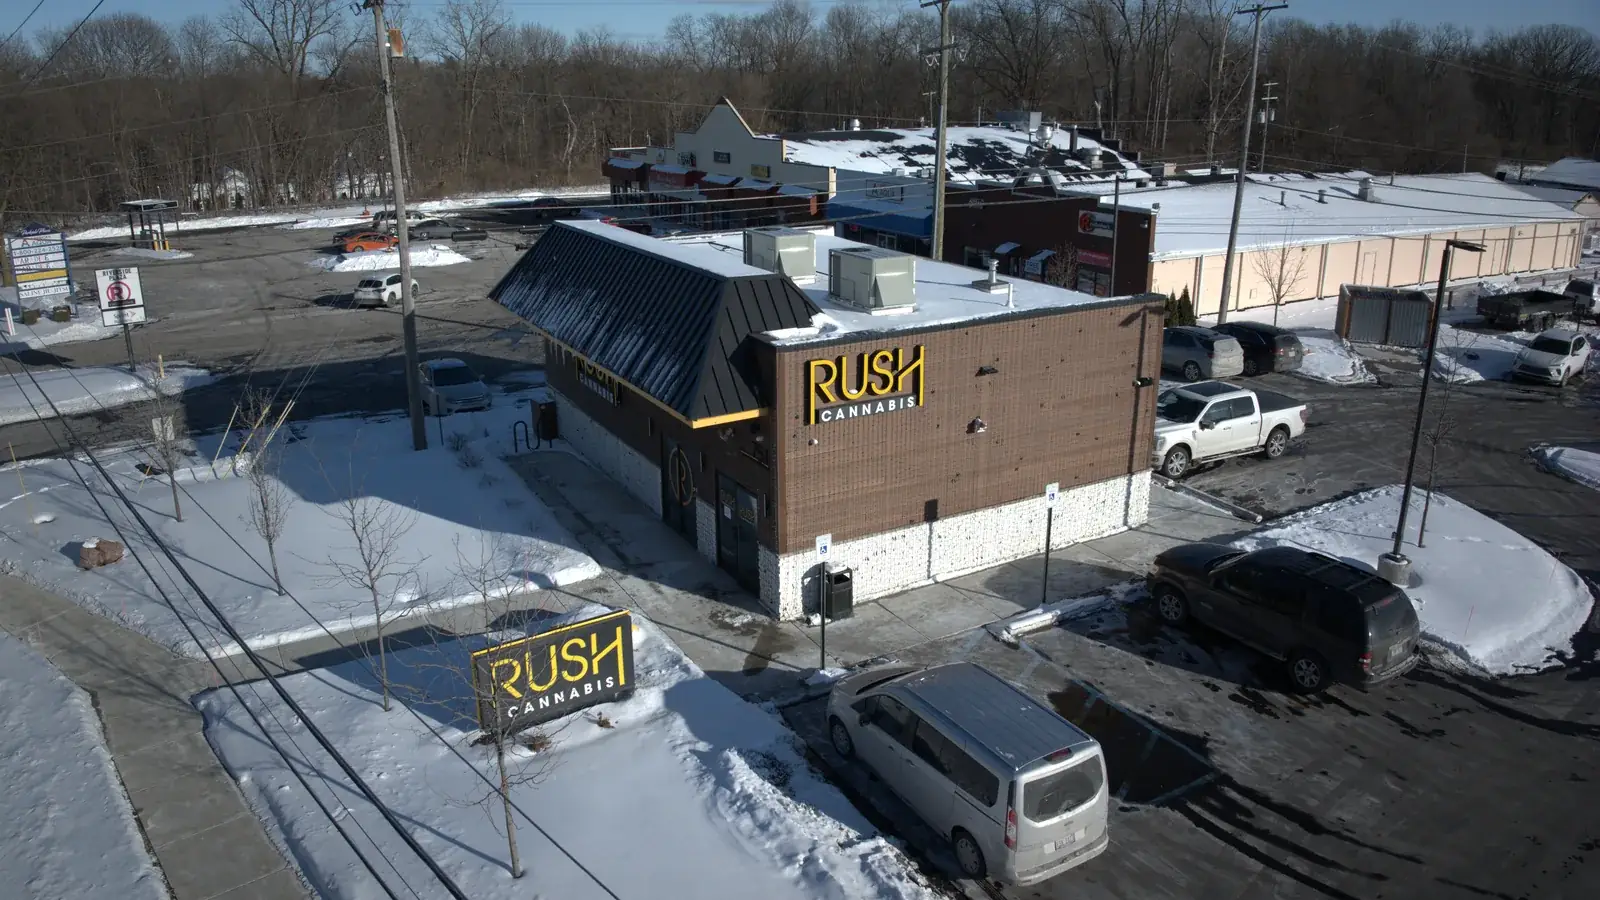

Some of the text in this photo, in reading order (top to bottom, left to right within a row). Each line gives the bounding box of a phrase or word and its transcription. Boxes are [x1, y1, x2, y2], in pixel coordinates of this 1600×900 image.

[808, 345, 925, 425] RUSH
[821, 396, 916, 422] CANNABIS
[490, 626, 625, 709] RUSH
[507, 676, 615, 718] CANNABIS
